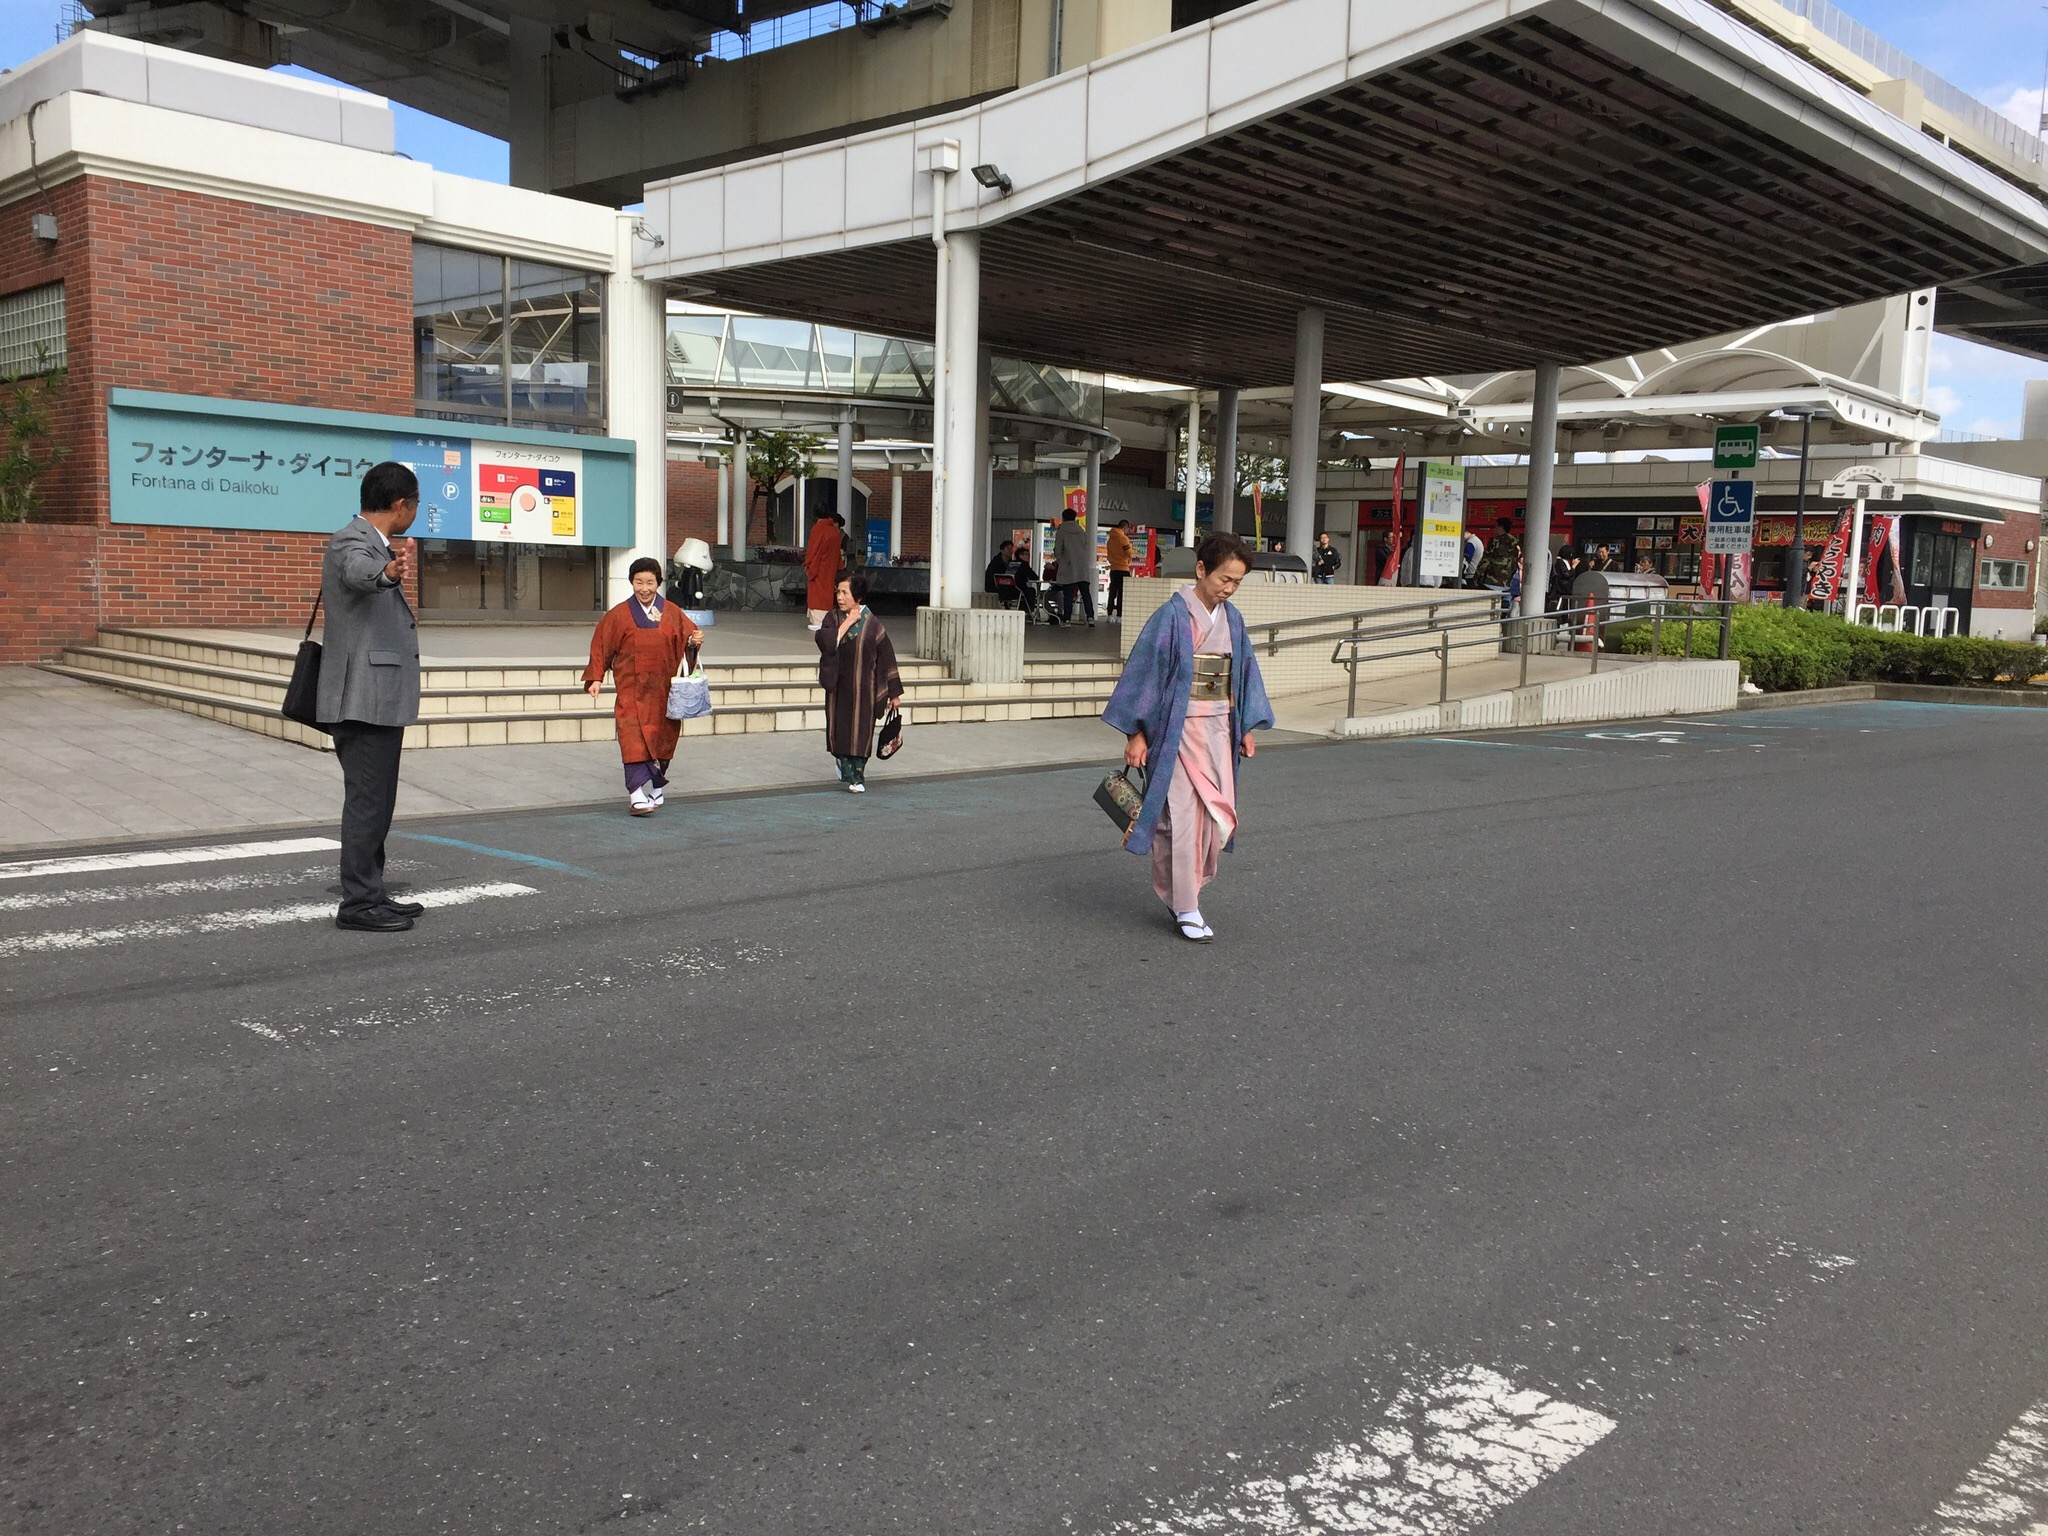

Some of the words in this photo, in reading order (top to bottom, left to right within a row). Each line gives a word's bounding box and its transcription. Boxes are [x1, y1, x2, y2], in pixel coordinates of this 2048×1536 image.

[131, 442, 374, 479] フォンターナ・ダイコク
[131, 472, 197, 492] Fontana
[201, 477, 214, 492] di
[219, 478, 280, 496] Daikoku
[1831, 484, 1895, 499] 二番館
[1098, 498, 1129, 512] RINK
[1708, 526, 1751, 534] 専用駐車場
[1811, 536, 1844, 599] たこやき
[1863, 523, 1884, 602] 肉ん
